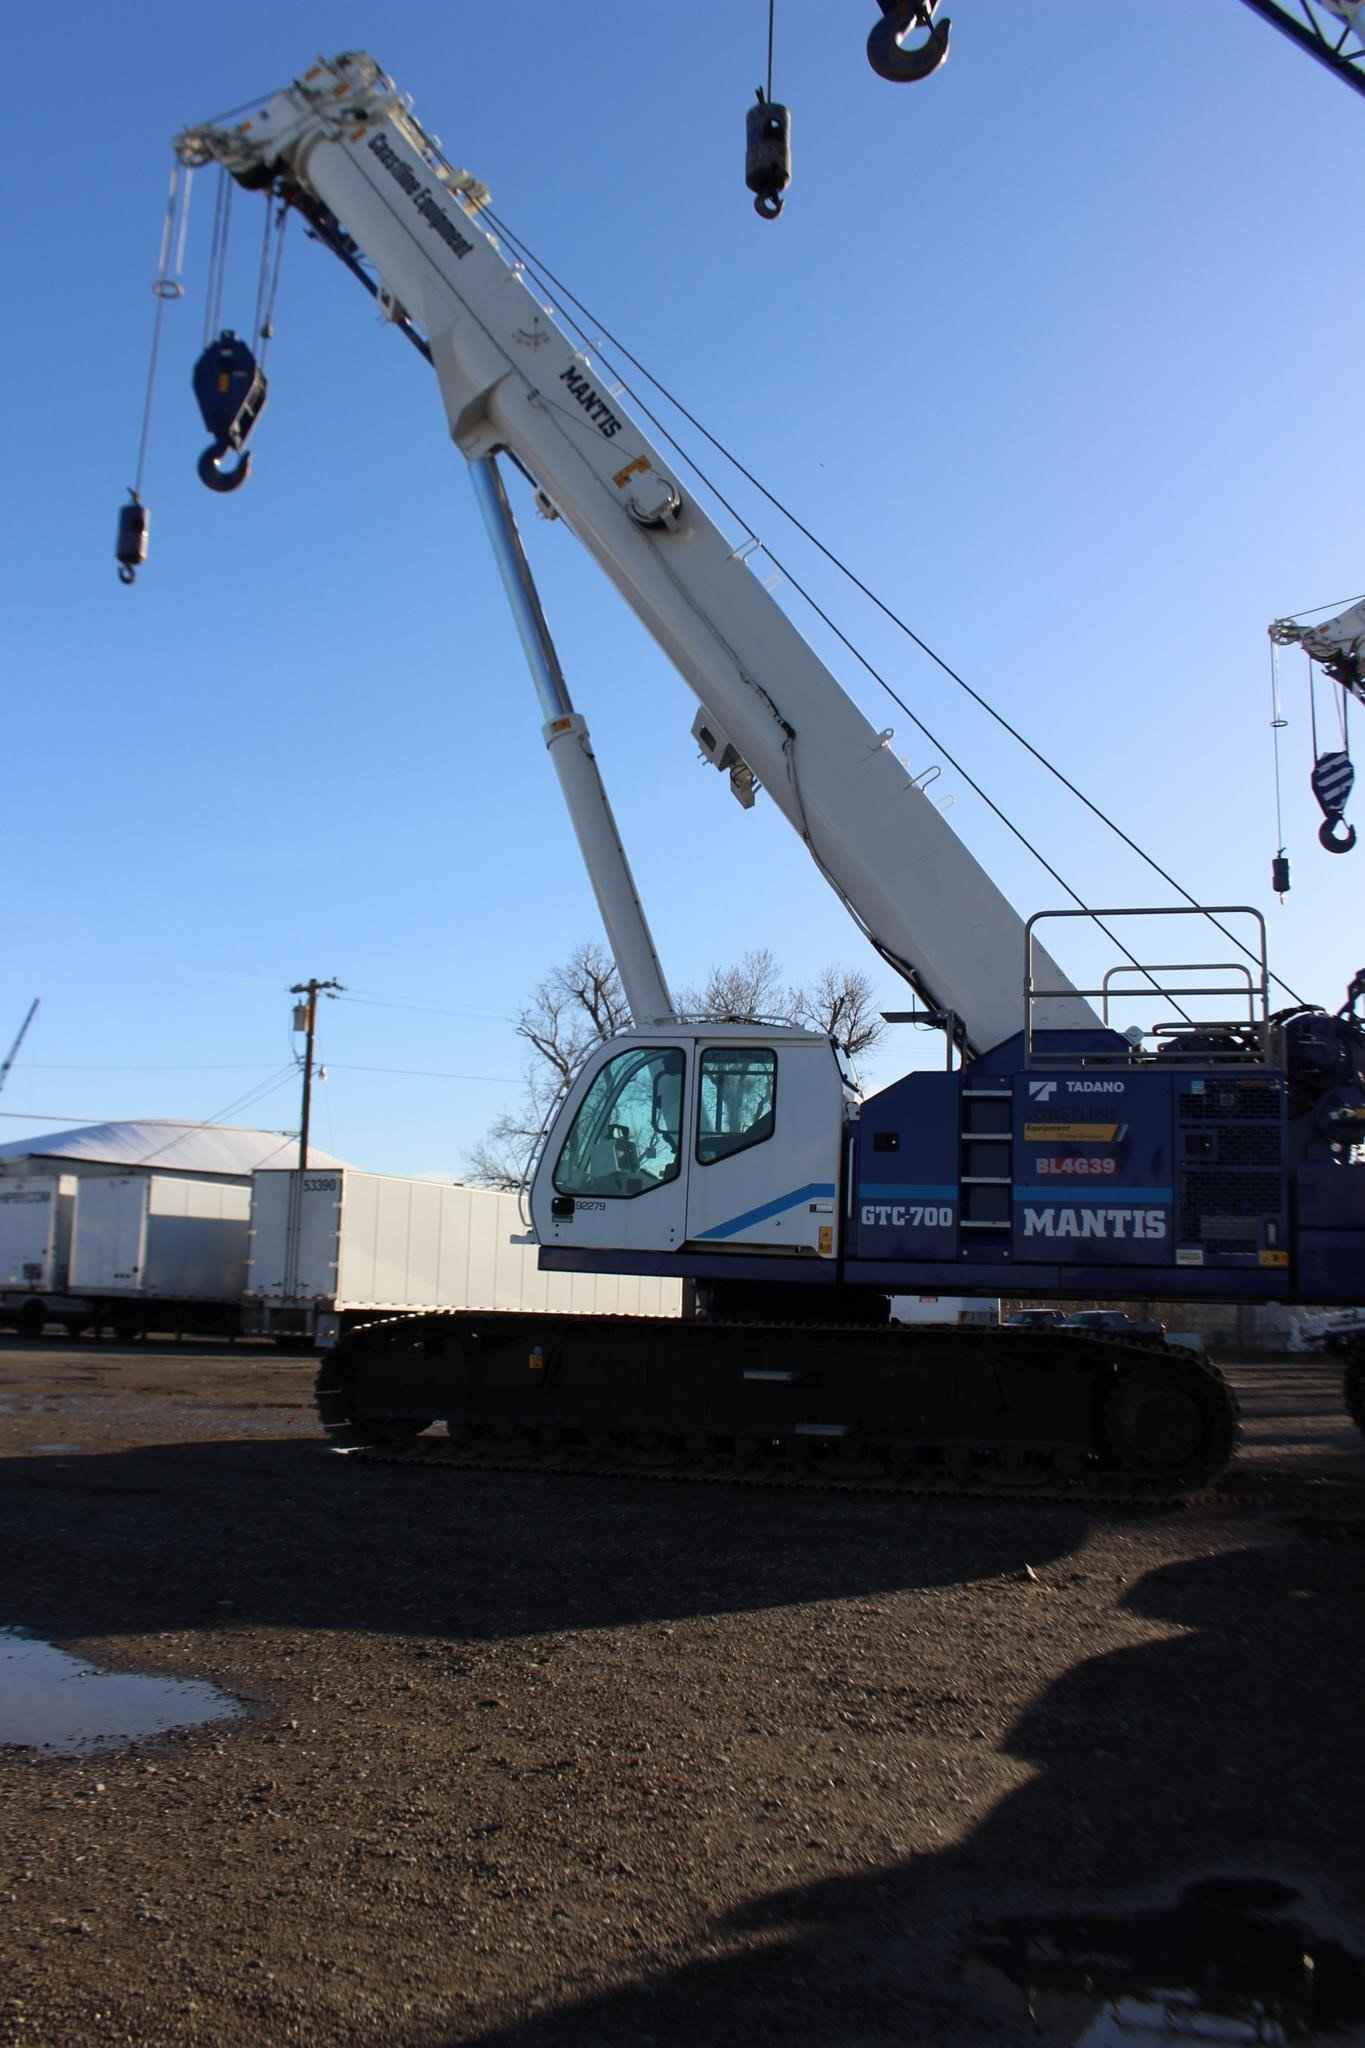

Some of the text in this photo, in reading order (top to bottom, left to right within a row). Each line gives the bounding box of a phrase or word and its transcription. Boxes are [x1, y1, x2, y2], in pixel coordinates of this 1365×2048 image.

[413, 187, 475, 260] Equipment
[559, 364, 623, 439] MANTIS
[1065, 1081, 1126, 1093] TADANO
[1035, 1156, 1117, 1175] BL4G39
[575, 1200, 607, 1212] 92279
[860, 1205, 953, 1227] GTC-700
[1023, 1207, 1167, 1240] MANTIS
